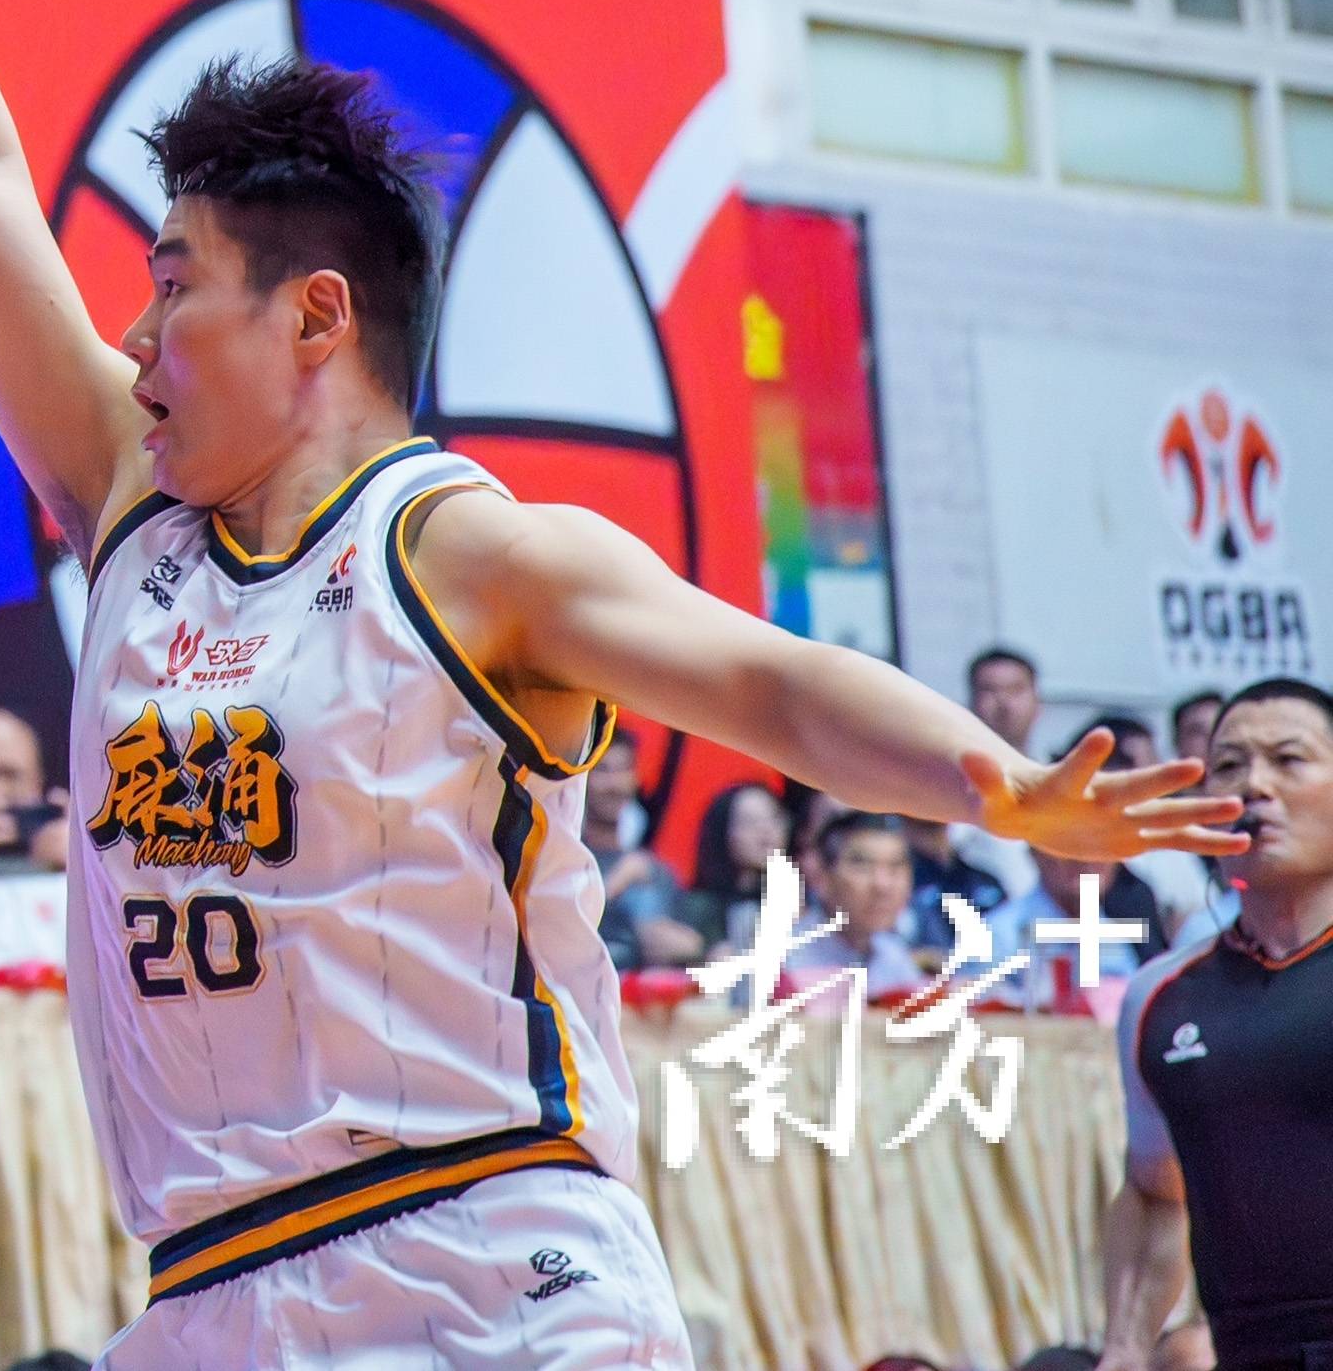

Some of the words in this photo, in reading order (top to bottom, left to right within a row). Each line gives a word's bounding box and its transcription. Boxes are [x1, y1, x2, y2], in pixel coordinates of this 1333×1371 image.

[311, 586, 353, 609] GBA
[1158, 583, 1311, 642] DGBA
[122, 890, 265, 1002] 20
